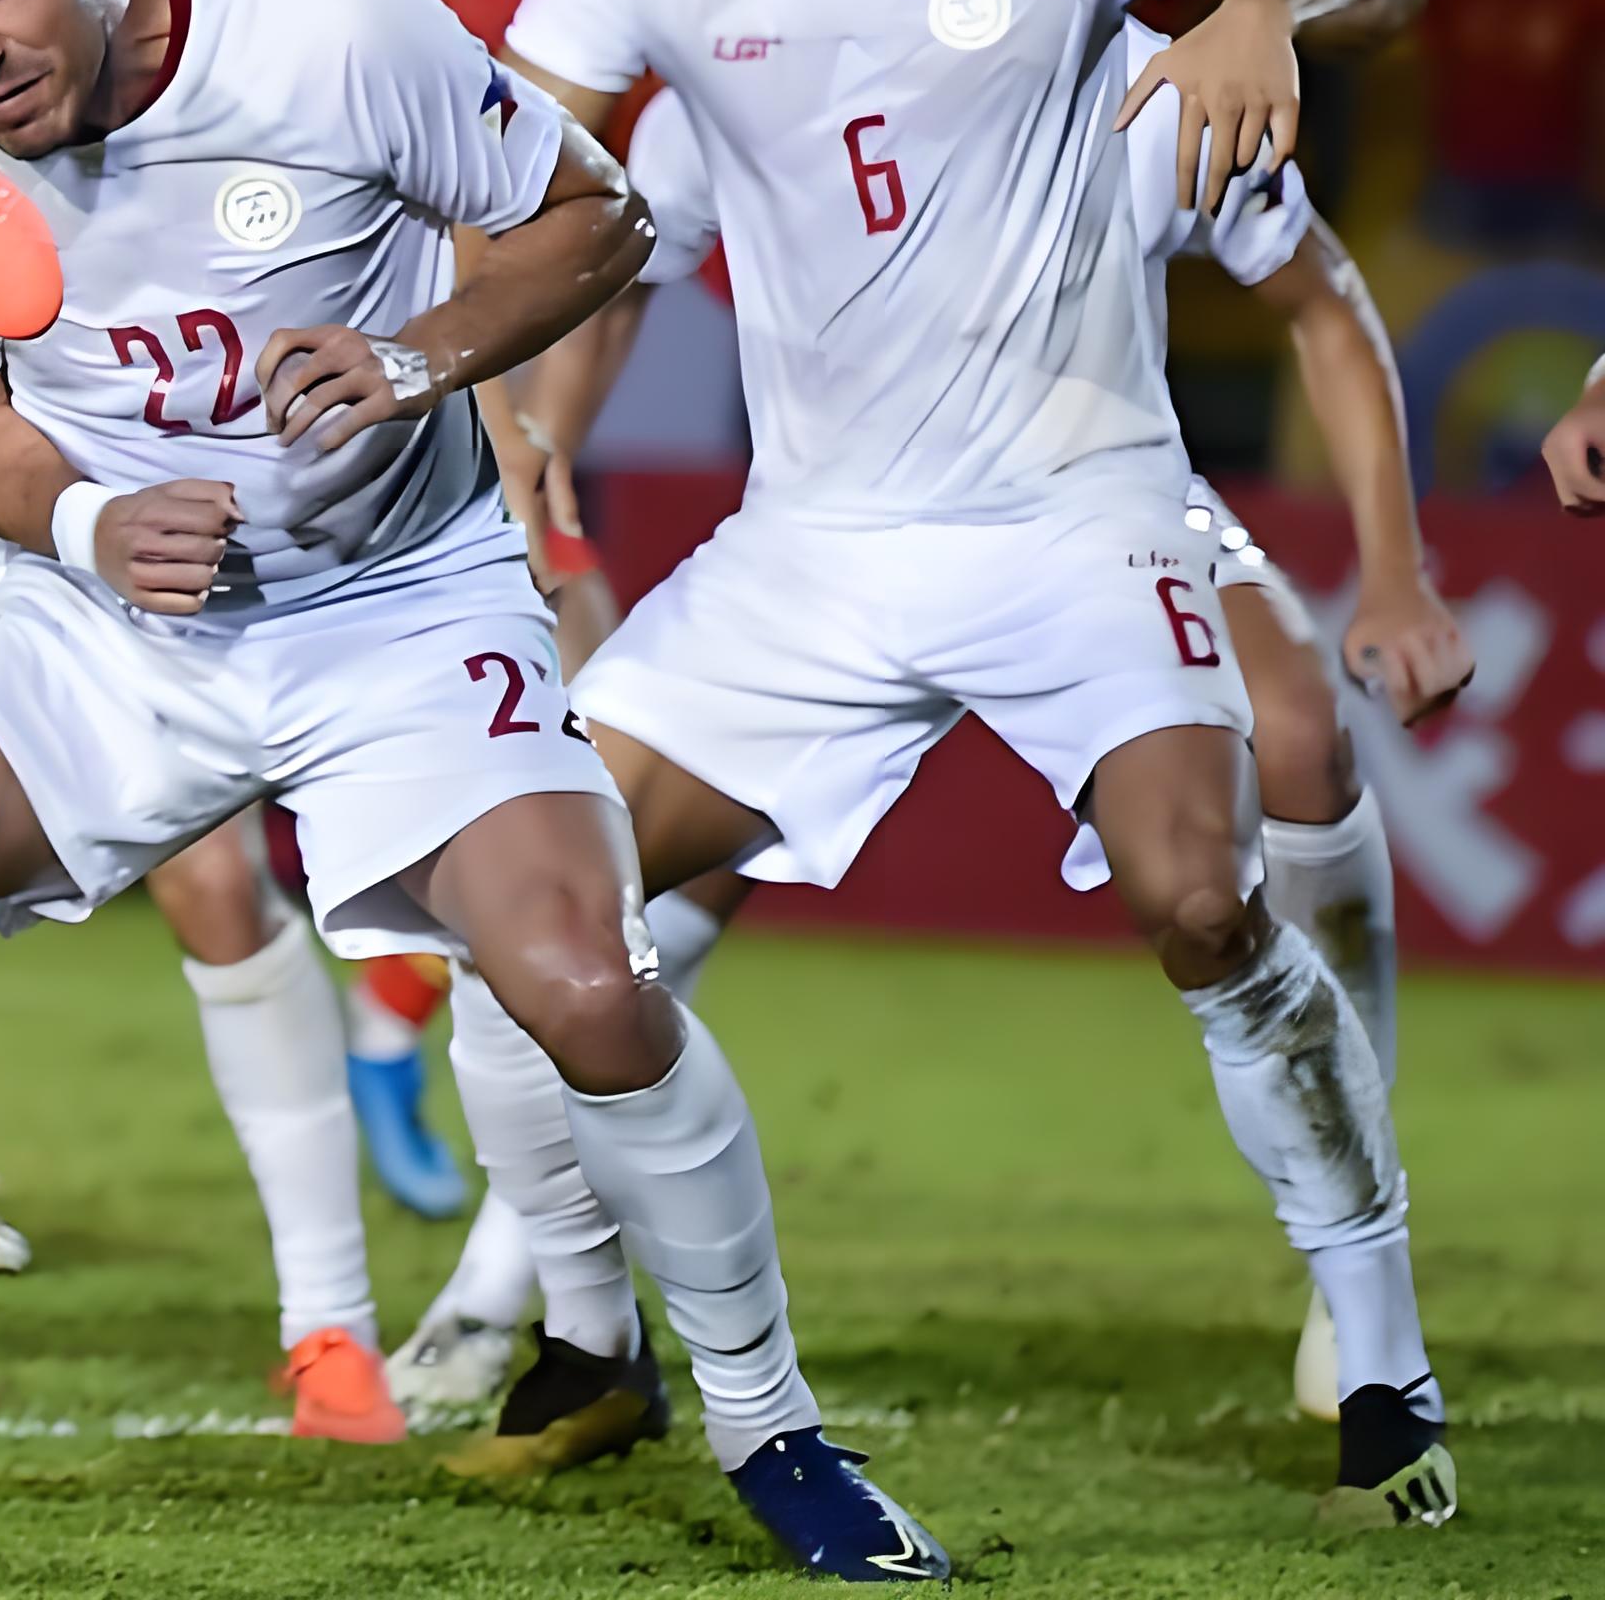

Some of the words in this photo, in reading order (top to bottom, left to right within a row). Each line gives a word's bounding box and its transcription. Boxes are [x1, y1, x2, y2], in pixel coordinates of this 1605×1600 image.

[843, 114, 907, 236] 6
[106, 308, 262, 438] 22
[1155, 576, 1221, 668] 6
